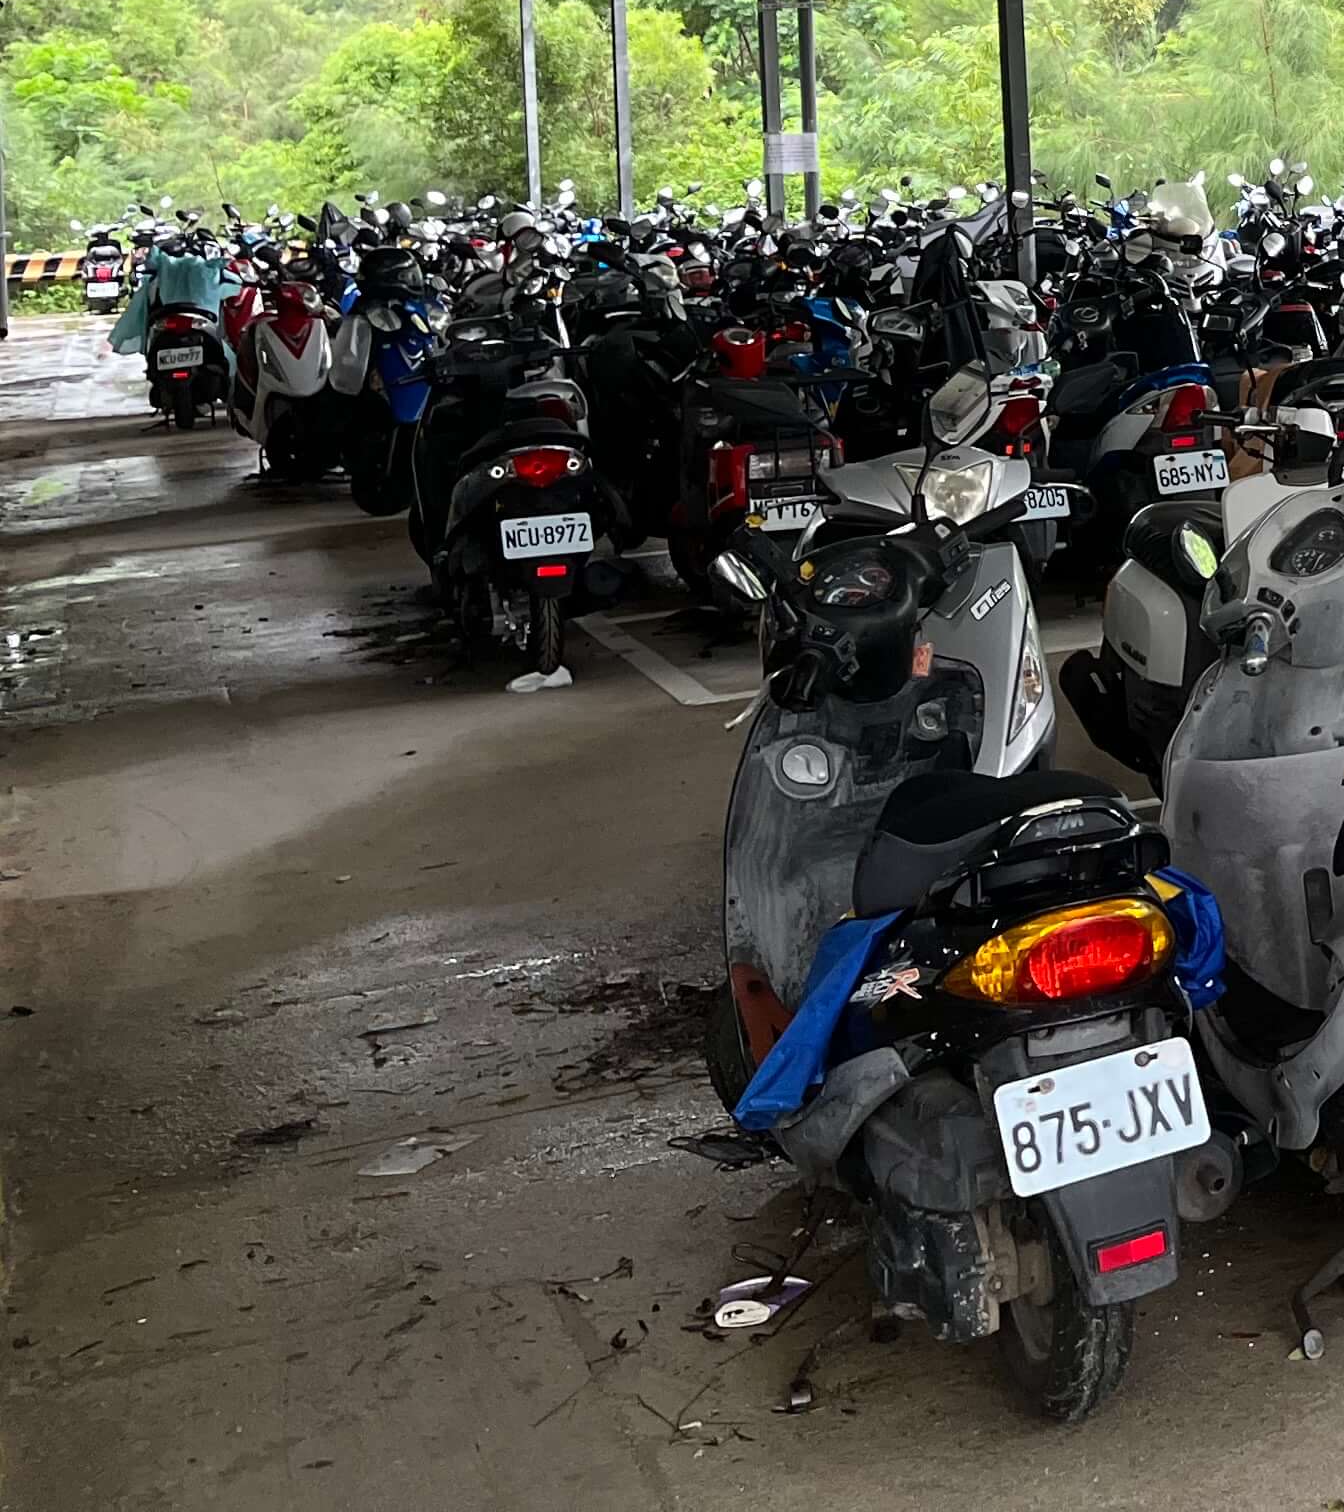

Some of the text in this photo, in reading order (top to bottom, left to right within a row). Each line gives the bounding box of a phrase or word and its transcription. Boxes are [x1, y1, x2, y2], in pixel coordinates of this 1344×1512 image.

[1159, 462, 1226, 488] 685-NYJ
[505, 522, 589, 549] NCU-8972
[1011, 1071, 1194, 1174] 875-JXV
